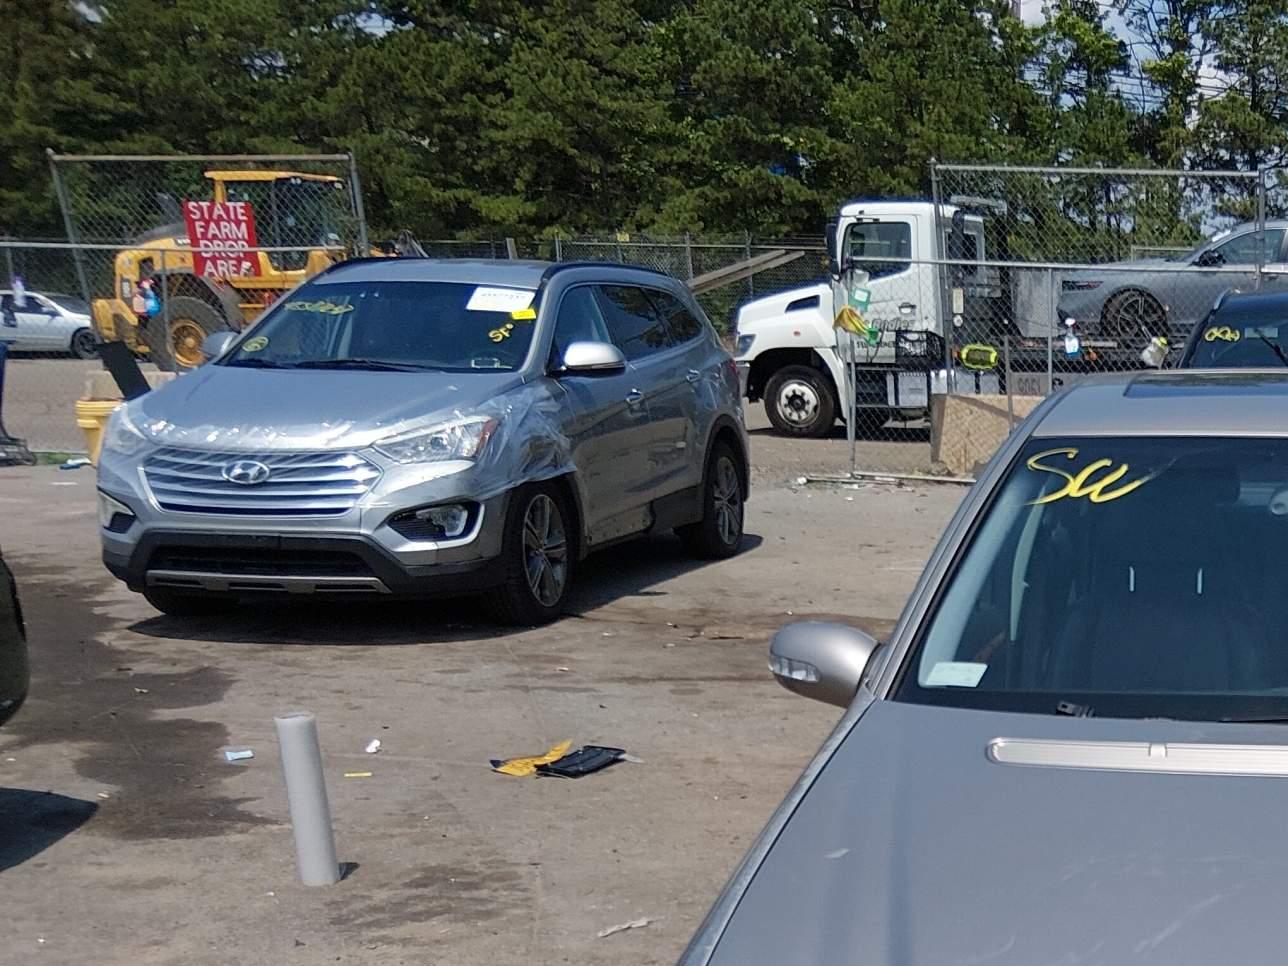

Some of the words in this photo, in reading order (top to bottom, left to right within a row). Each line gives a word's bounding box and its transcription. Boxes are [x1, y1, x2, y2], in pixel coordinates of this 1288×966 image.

[187, 201, 249, 220] STATE
[195, 221, 249, 240] FARM
[200, 239, 249, 258] DROP
